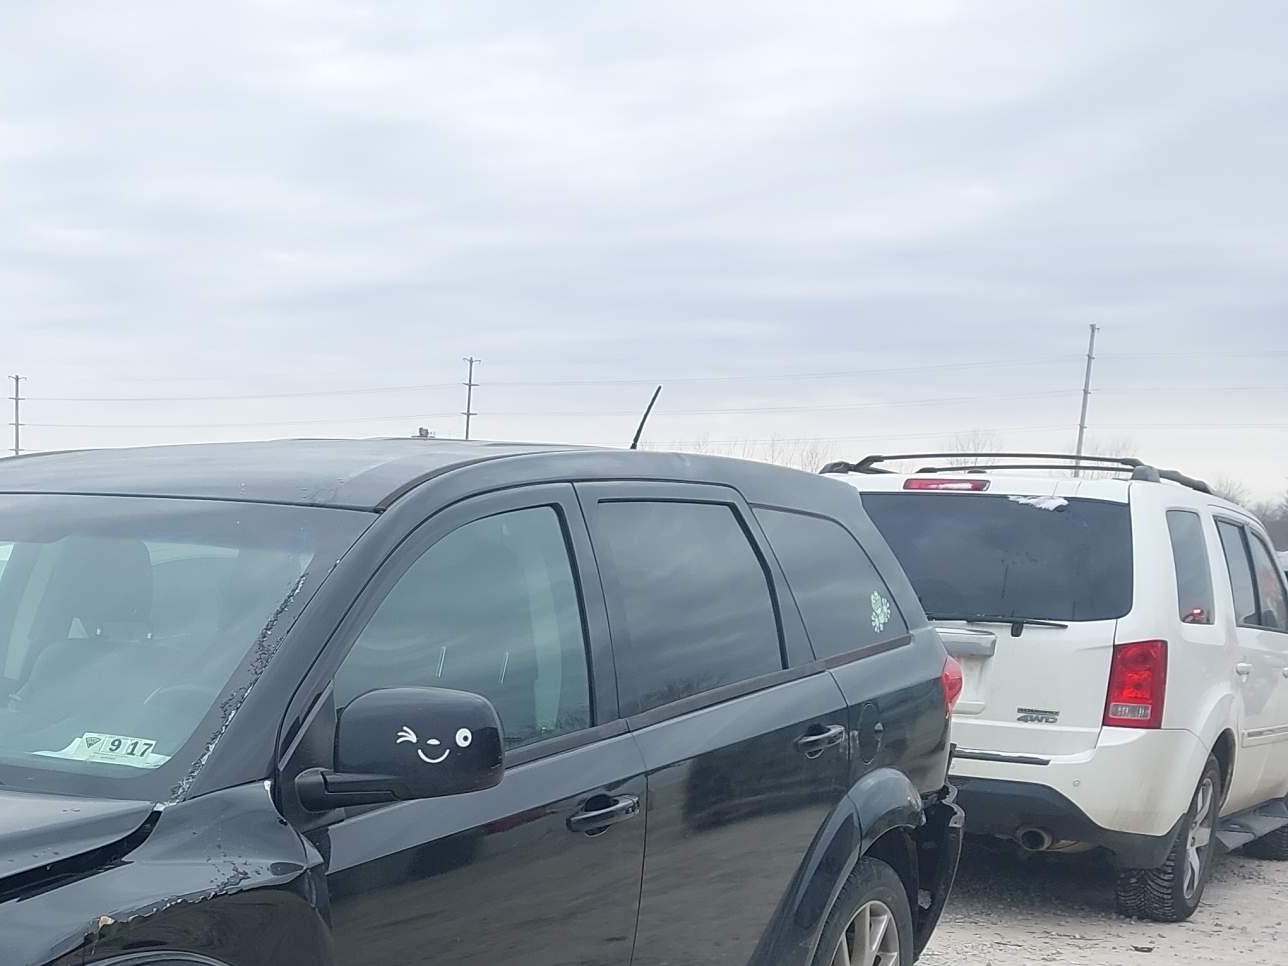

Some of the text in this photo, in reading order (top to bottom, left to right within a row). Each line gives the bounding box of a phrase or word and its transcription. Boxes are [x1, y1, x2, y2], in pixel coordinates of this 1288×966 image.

[1017, 714, 1058, 723] 4WD
[109, 738, 122, 752] 9
[126, 741, 154, 757] 17
